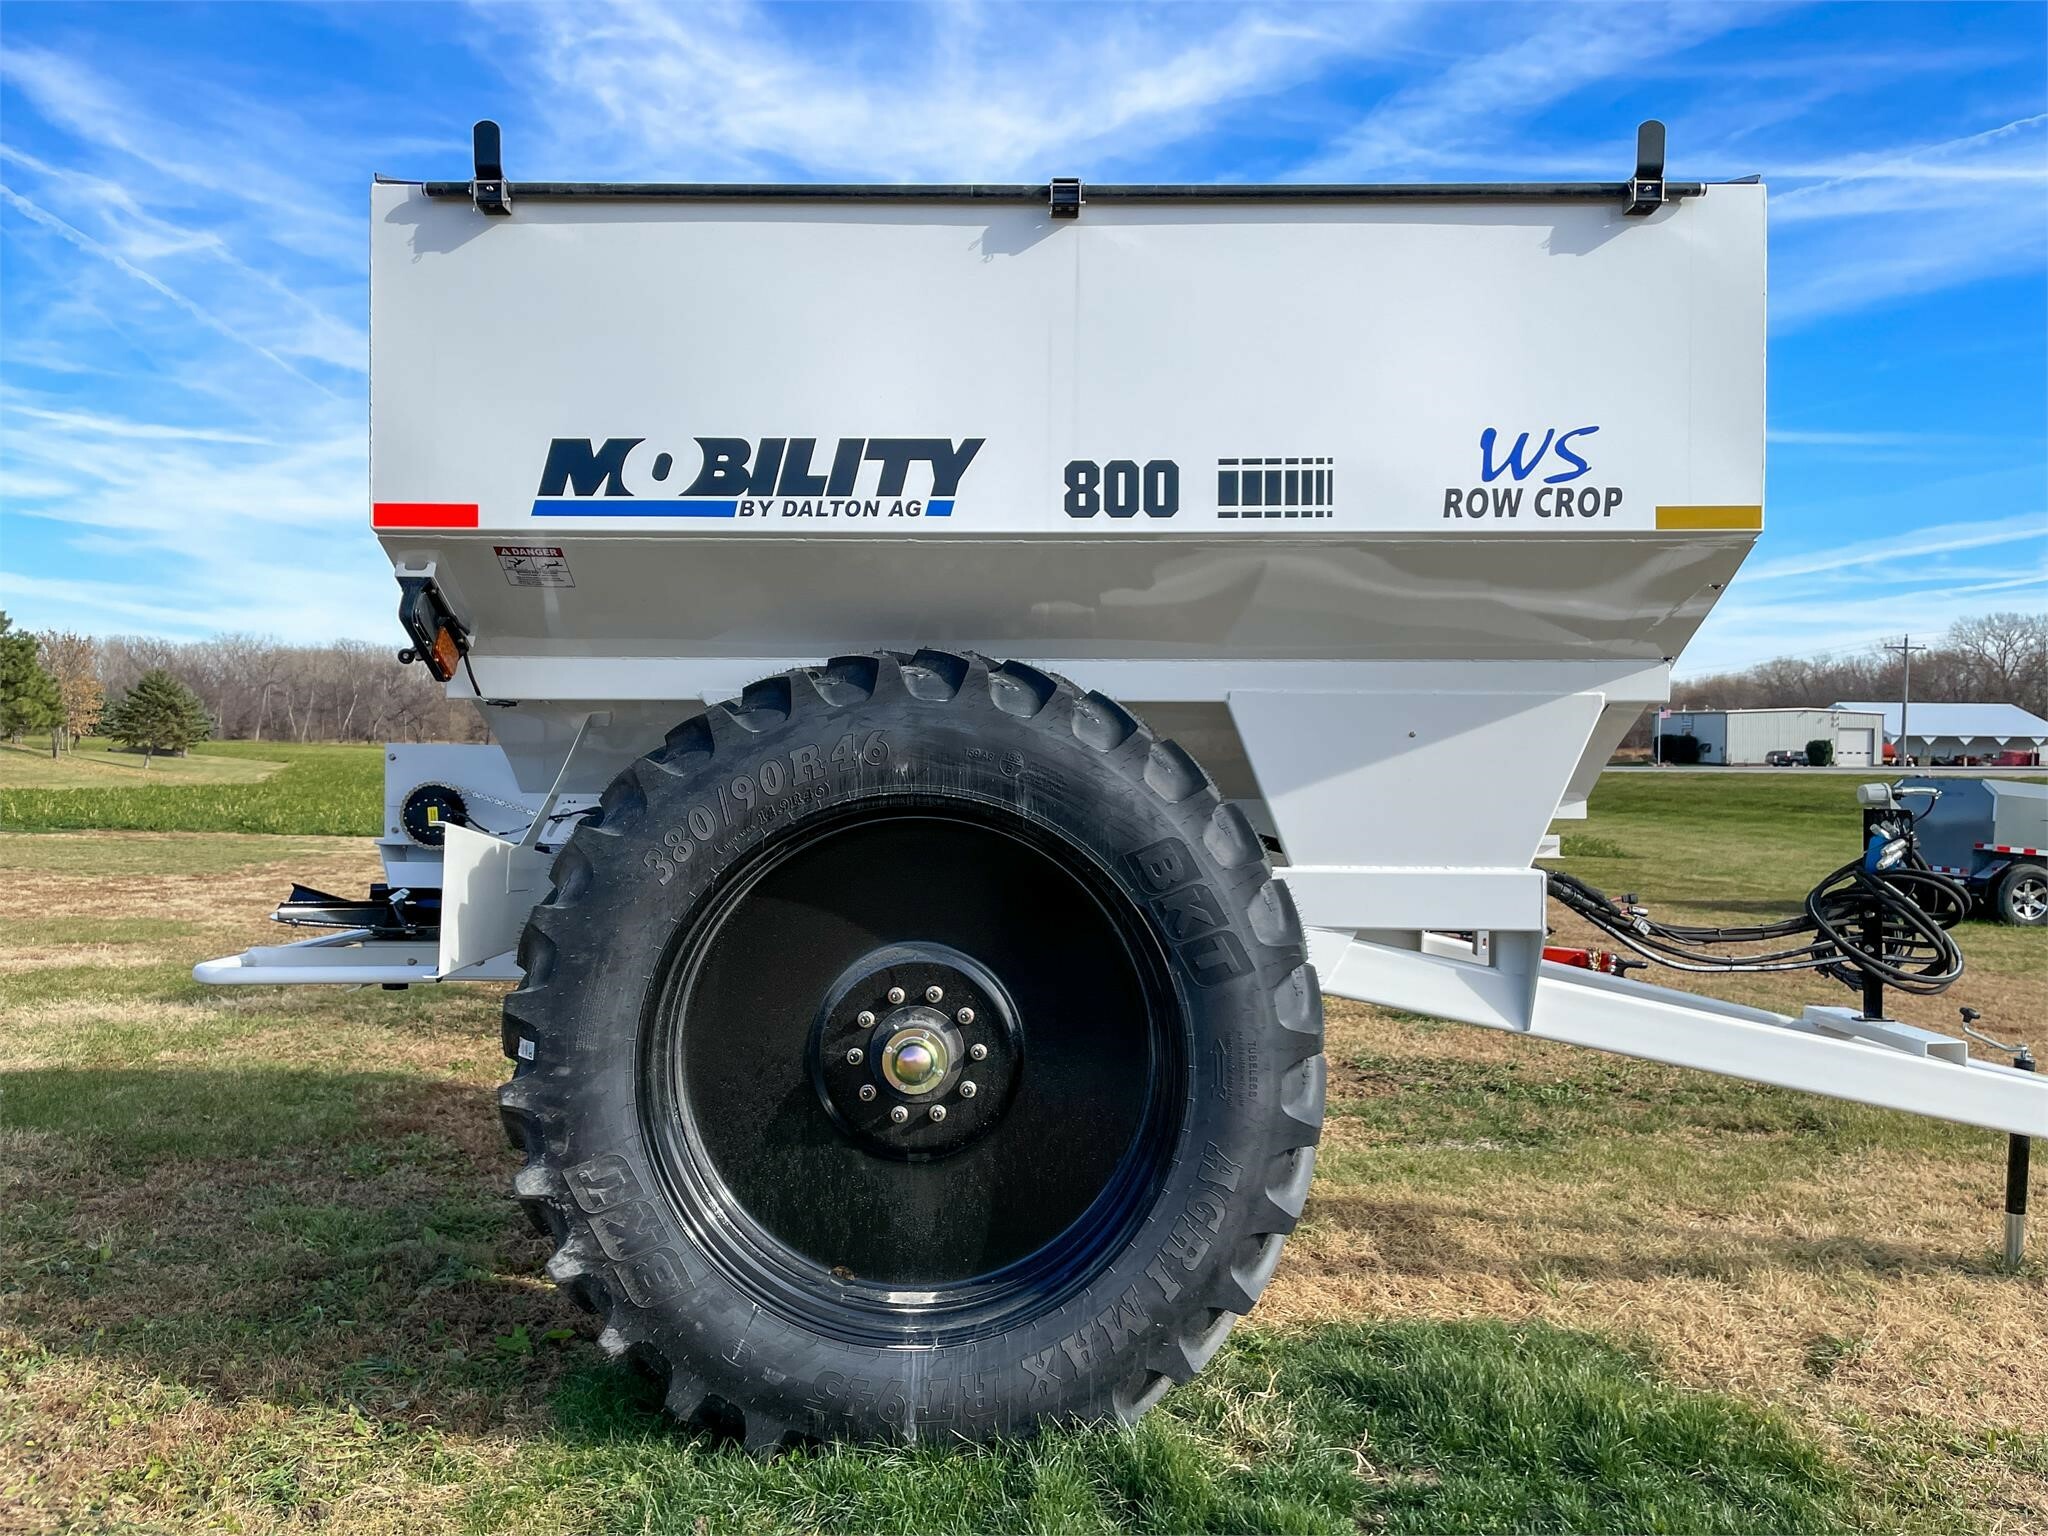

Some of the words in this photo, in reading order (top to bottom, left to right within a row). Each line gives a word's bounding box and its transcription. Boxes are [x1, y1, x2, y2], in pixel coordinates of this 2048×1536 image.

[537, 437, 986, 497] MOBILITY
[1480, 426, 1600, 484] WS
[739, 500, 772, 518] BY
[781, 500, 880, 518] DALTON
[888, 500, 923, 518] AG
[1064, 459, 1180, 518] 800
[1443, 487, 1525, 519] ROW
[1534, 487, 1624, 519] CROP
[511, 547, 559, 557] DANGER
[1136, 842, 1243, 975] BKT
[576, 1168, 684, 1302] BKT
